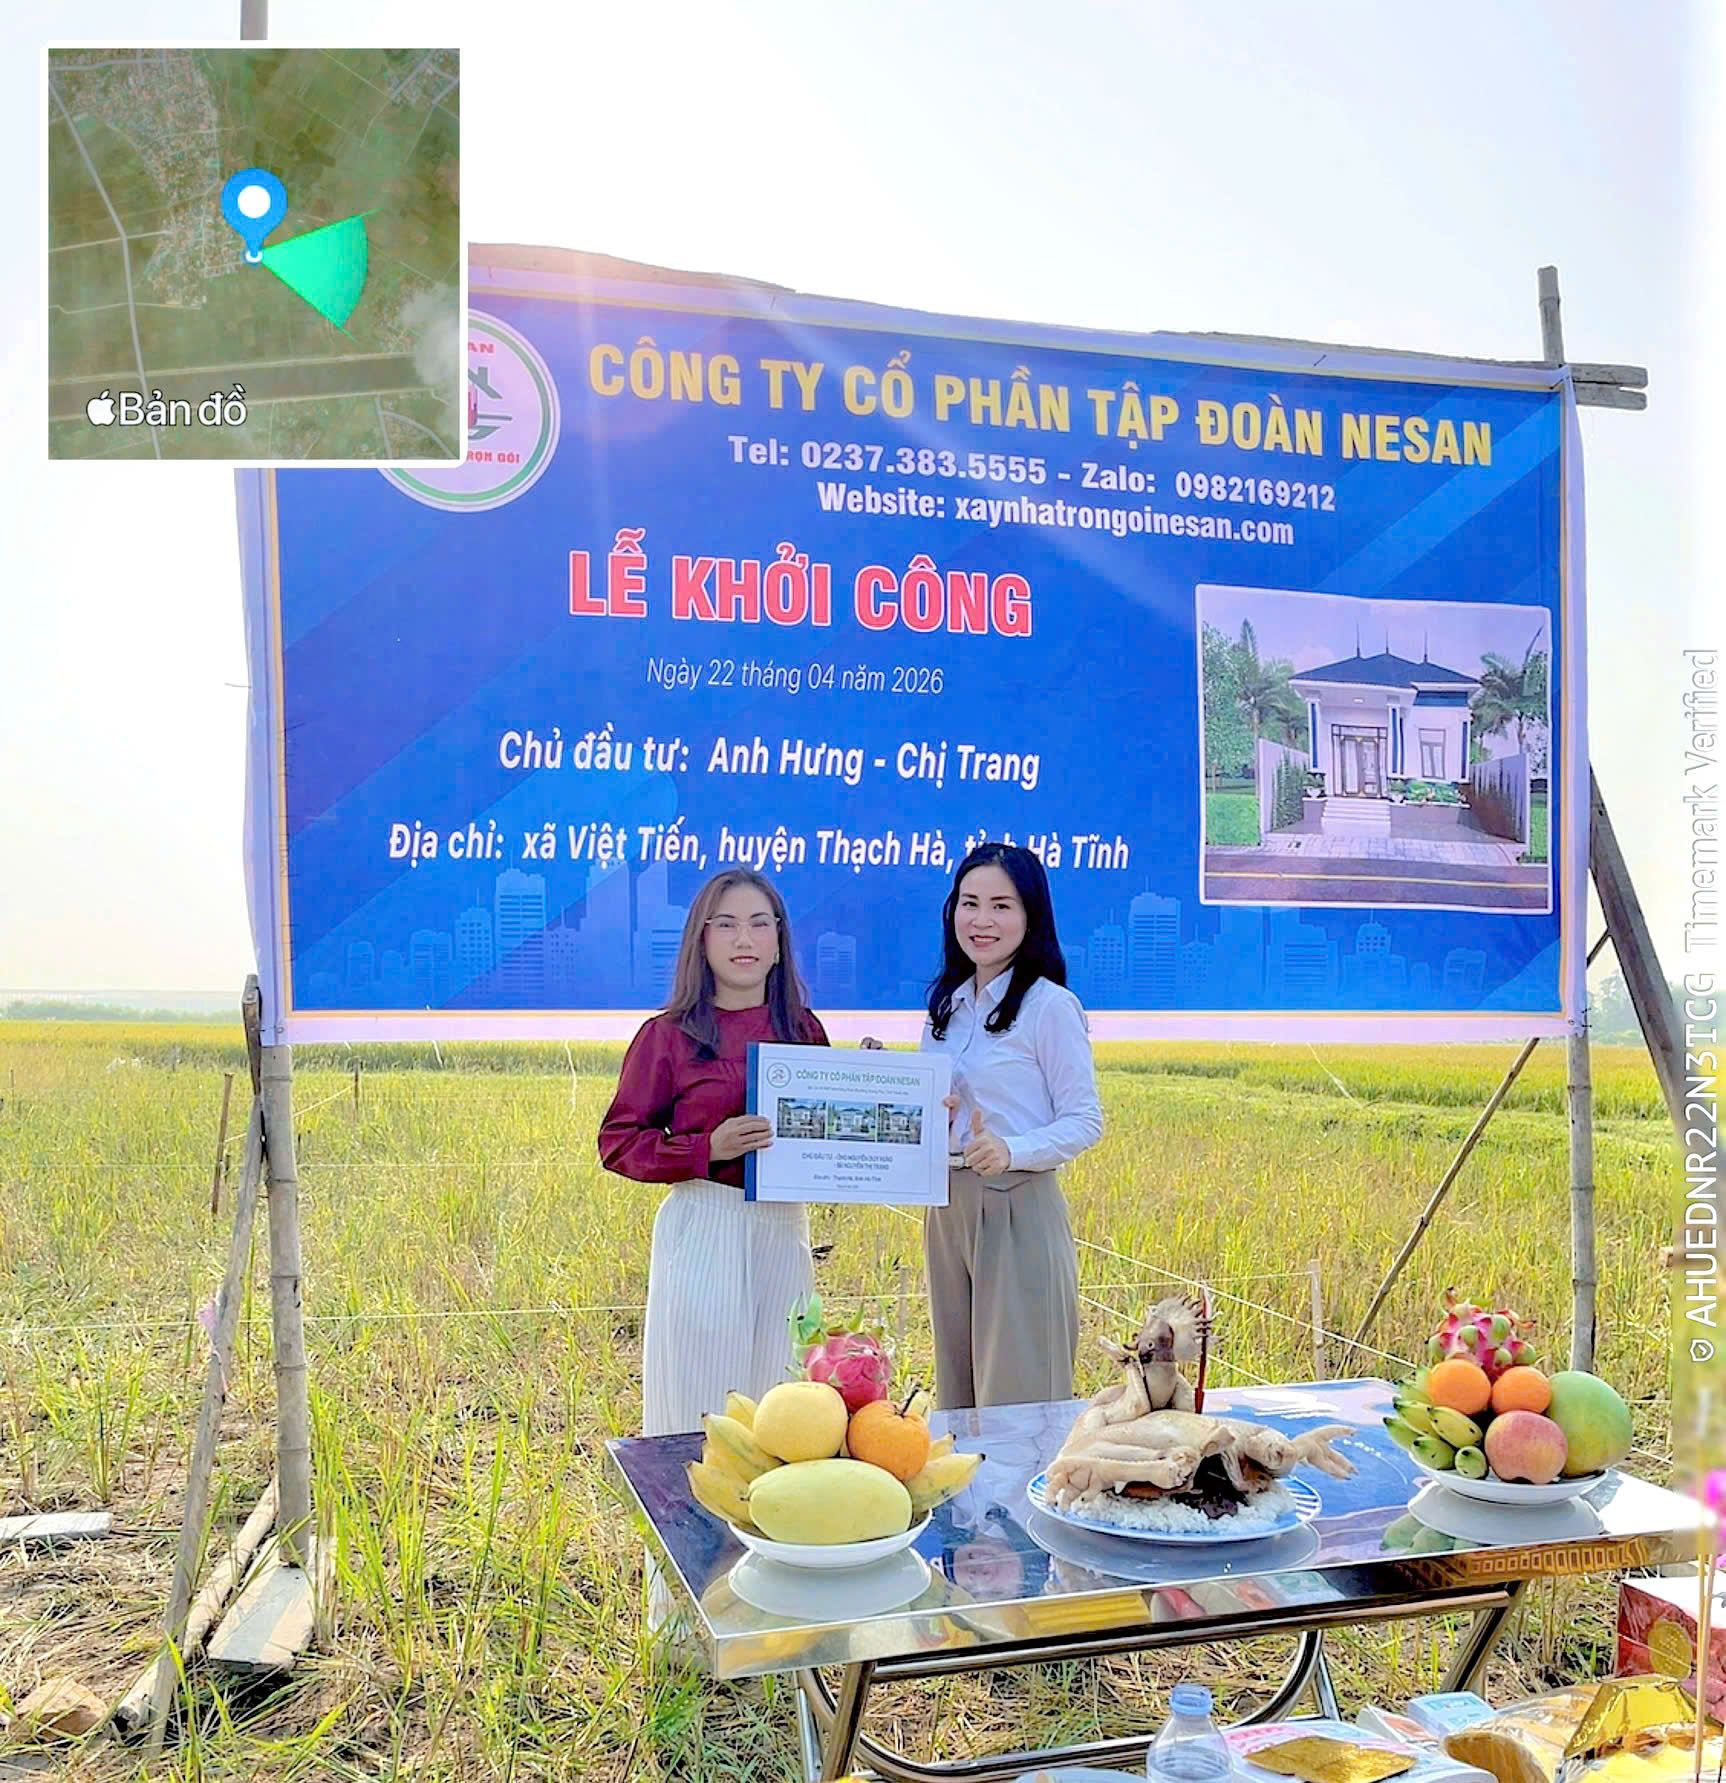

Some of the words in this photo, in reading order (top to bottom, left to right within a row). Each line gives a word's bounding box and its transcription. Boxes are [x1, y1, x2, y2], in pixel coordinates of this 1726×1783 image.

[590, 336, 741, 406] CÔNG
[760, 358, 824, 411] TY
[844, 350, 915, 418] CỔ
[934, 365, 1070, 432] PHẦN
[1087, 381, 1179, 449] TẬP
[1196, 393, 1322, 457] ĐOÀN
[1342, 412, 1492, 466] NESAN
[467, 449, 492, 463] RỌN
[728, 435, 789, 466] Tel:
[801, 441, 1046, 485] 0237.383.5555
[1081, 463, 1156, 494] Zalo:
[1175, 471, 1336, 512] 0982169212
[818, 482, 945, 519] Website:
[955, 496, 1295, 545] xaynhatrongoinesan.com
[568, 527, 647, 617] LỄ
[672, 542, 832, 627] KHỞI
[854, 554, 1033, 637] CÔNG
[646, 657, 702, 690] Ngày
[707, 659, 735, 687] 22
[741, 660, 800, 694] tháng
[807, 663, 835, 689] 04
[841, 664, 885, 692] năm
[891, 666, 944, 694] 2026
[499, 728, 562, 769] Chủ
[572, 722, 632, 771] đầu
[643, 736, 690, 772] tư:
[707, 737, 768, 774] Anh
[779, 738, 864, 786] Hưng
[873, 757, 886, 768] -
[896, 740, 948, 789] Chị
[957, 744, 1040, 791] Trang
[388, 820, 438, 869] Địa
[447, 819, 505, 859] chỉ:
[521, 822, 557, 860] xã
[568, 822, 628, 870] Việt
[637, 815, 708, 871] Tiến,
[718, 825, 806, 873] huyện
[816, 830, 901, 874] Thạch
[909, 828, 953, 875] Hà,
[1027, 832, 1062, 869] Hà
[1071, 833, 1130, 870] Tĩnh
